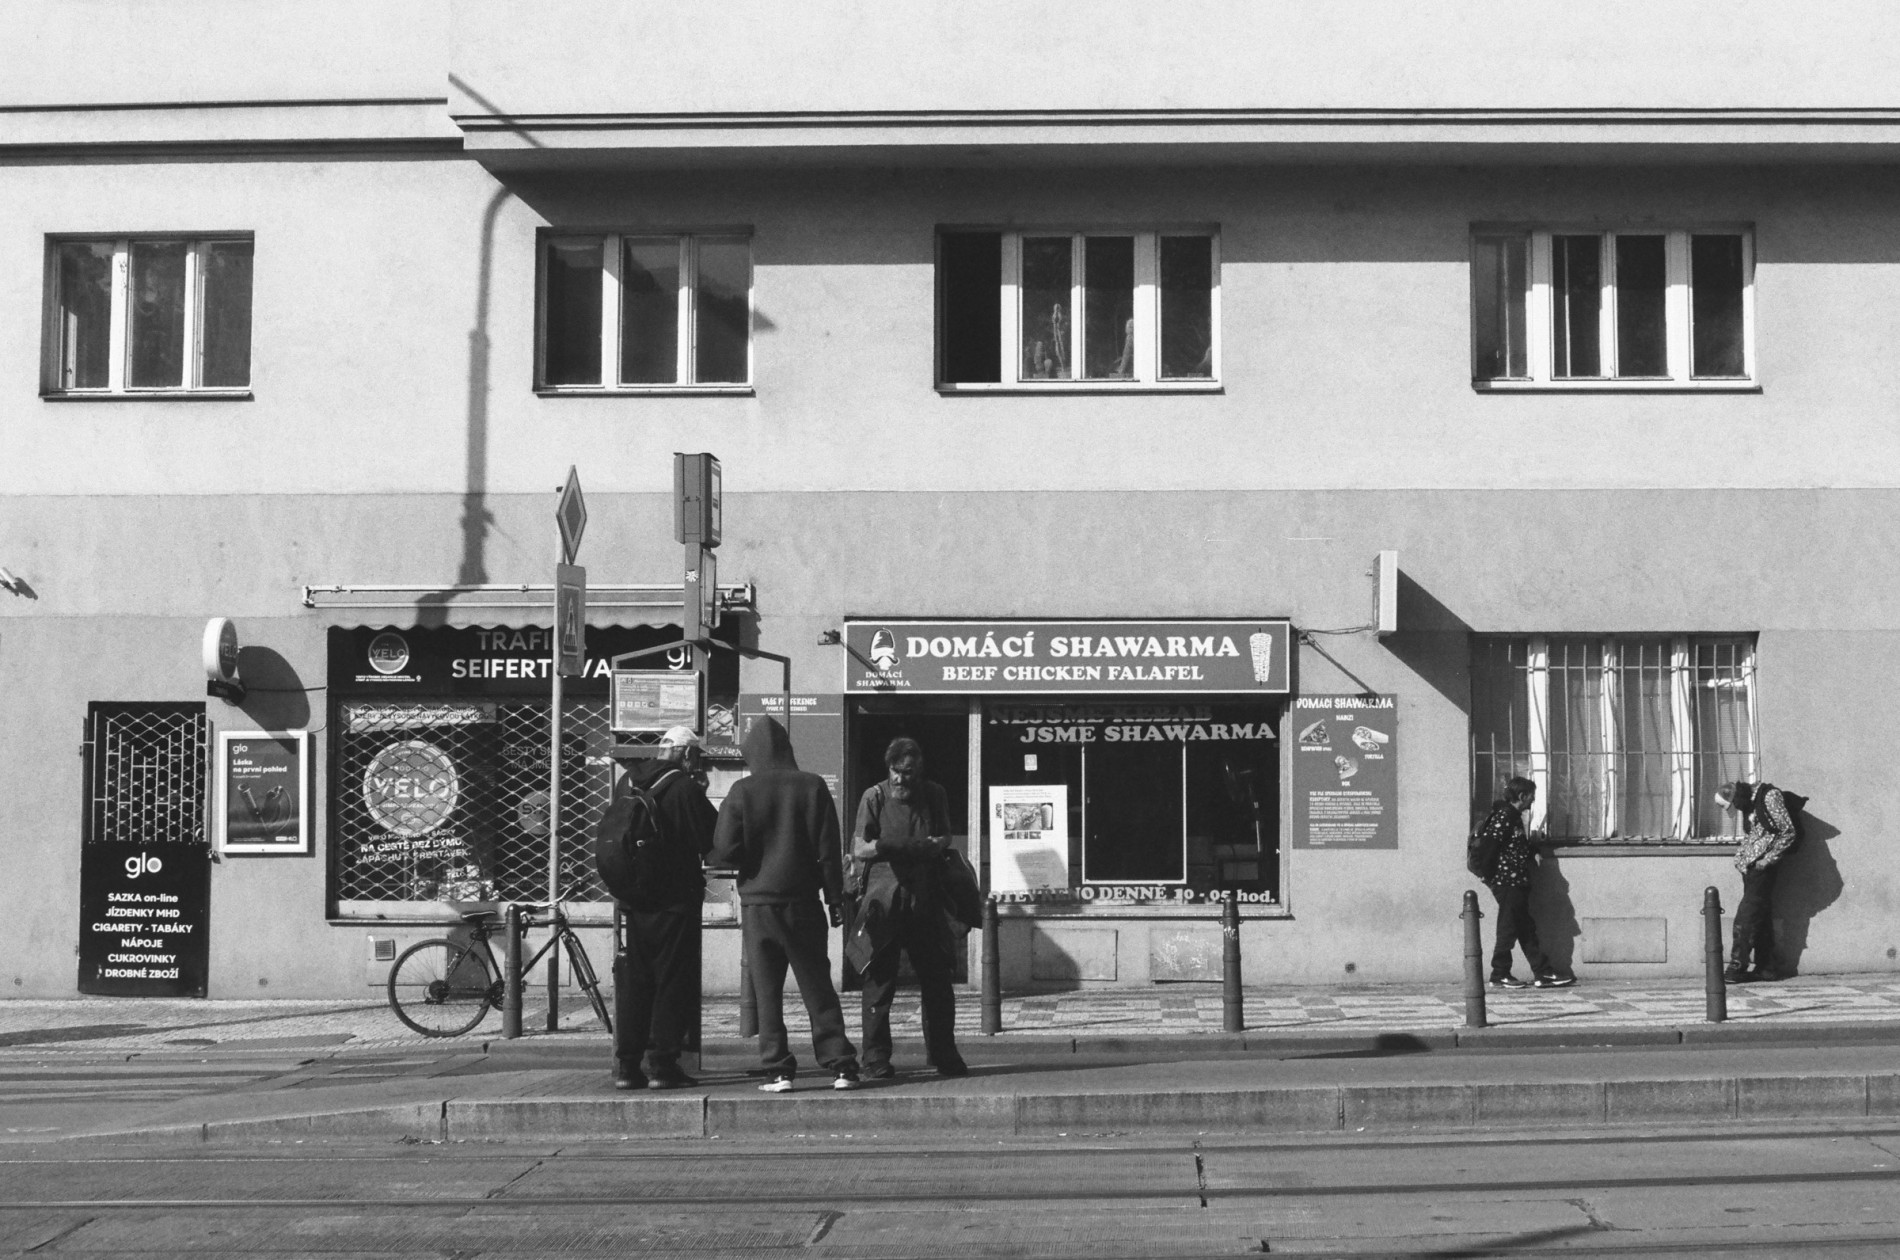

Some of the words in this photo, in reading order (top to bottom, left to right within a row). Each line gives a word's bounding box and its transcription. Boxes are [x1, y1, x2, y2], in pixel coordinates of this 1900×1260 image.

[476, 631, 587, 650] TRAFI
[905, 631, 1035, 658] DOMÁCÍ
[1049, 635, 1241, 658] SHAWARMA
[372, 648, 406, 658] VELO
[666, 645, 711, 670] gl
[451, 658, 611, 679] SEIFERTVA
[865, 670, 903, 679] DOMÁCÍ
[942, 666, 998, 681] BEEF
[1003, 666, 1101, 681] CHICKEN
[1107, 665, 1204, 681] FALAFEL
[856, 679, 912, 687] SHAWARMA
[778, 697, 817, 706] PFERENCE
[1334, 697, 1394, 709] SHAWARMA
[1020, 726, 1096, 743] JSME
[1104, 723, 1276, 742] SHAWARMA
[232, 743, 248, 755] glo
[262, 766, 287, 774] pohled
[373, 777, 450, 798] VELO
[125, 851, 162, 879] glo
[107, 893, 142, 902] SAZKA
[143, 893, 179, 903] on-line
[1099, 883, 1167, 901] DENNĚ
[1173, 888, 1193, 901] 10
[1236, 889, 1276, 904] hod.
[105, 905, 154, 917] JÍZDENKY
[156, 908, 181, 918] MHD
[92, 922, 143, 932] CIGARETY
[151, 922, 193, 933] TABÁKY
[121, 936, 163, 948] NÁPOJE
[107, 953, 177, 964] CUKROVINKY
[105, 967, 148, 978] DROBNÉ
[148, 967, 179, 979] ZBOŽÍ
